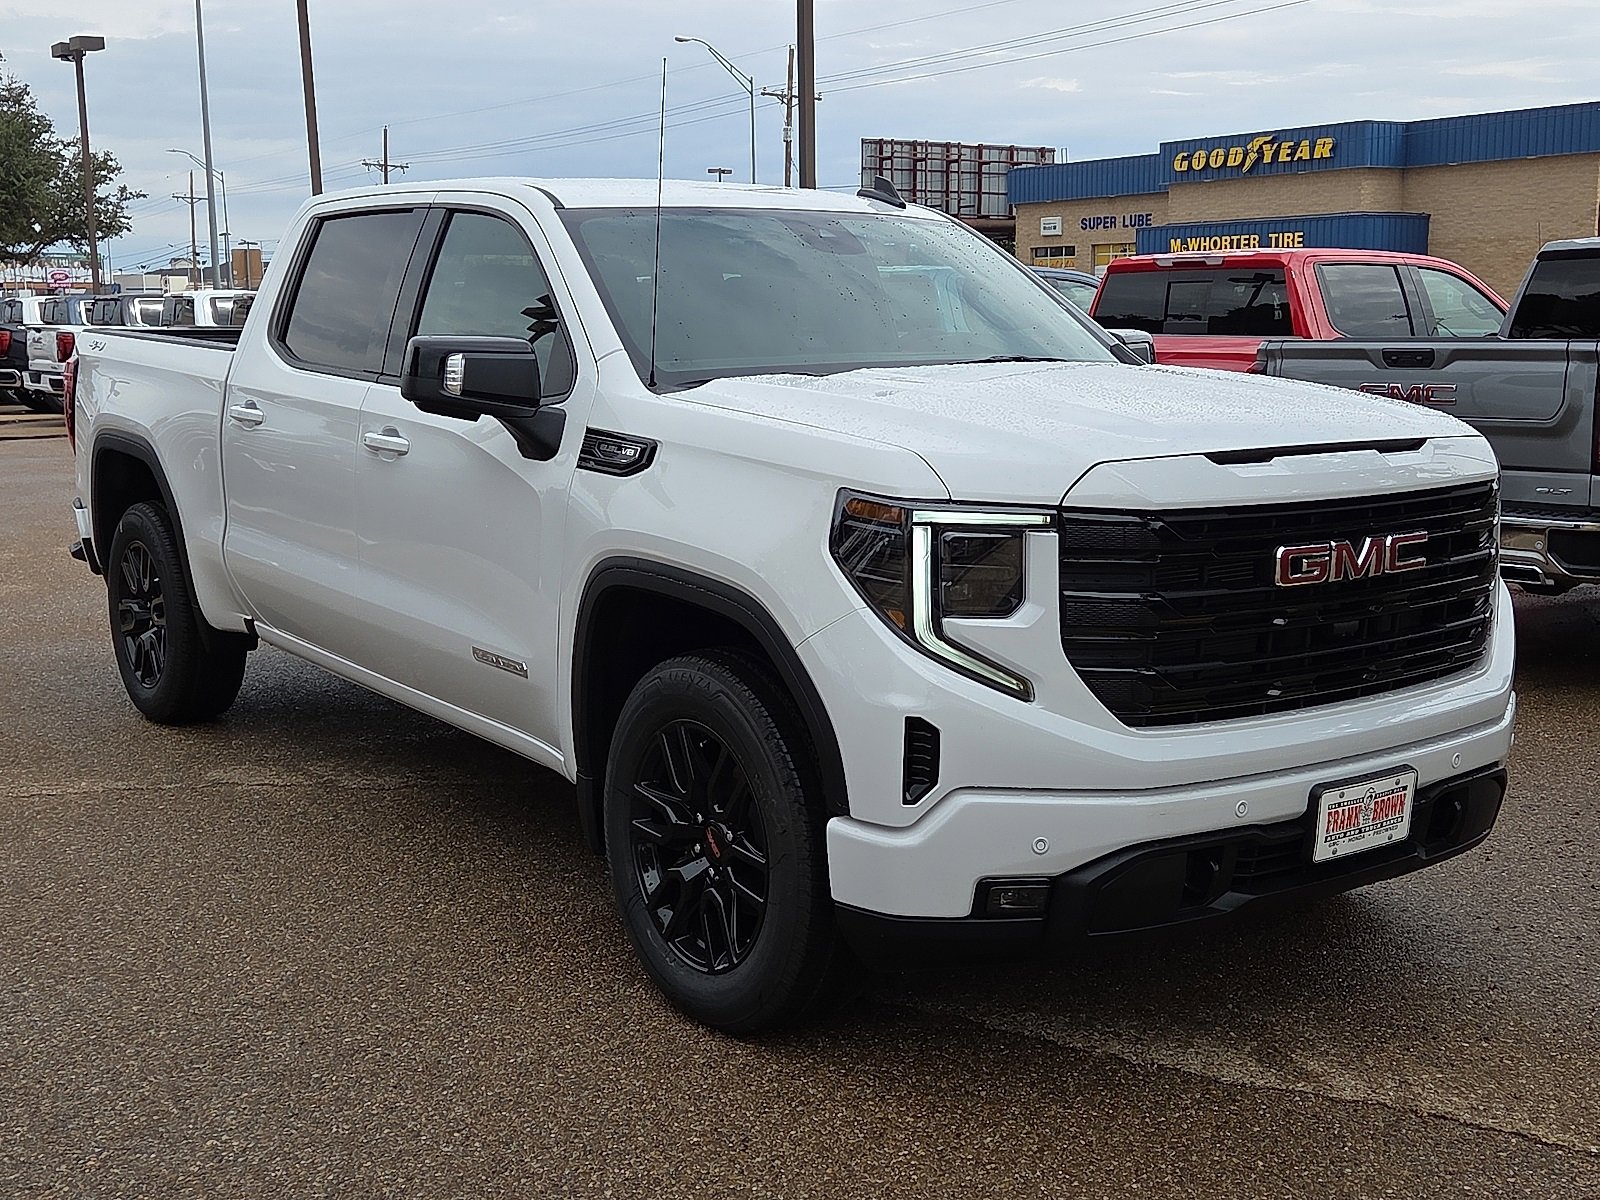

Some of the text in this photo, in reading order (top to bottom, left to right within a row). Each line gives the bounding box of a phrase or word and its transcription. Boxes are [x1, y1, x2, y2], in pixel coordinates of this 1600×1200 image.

[1173, 136, 1335, 173] GOODYEAR
[1080, 213, 1153, 230] SUPER LUBE
[1170, 231, 1304, 253] McWHORTER TIRE
[1359, 382, 1457, 406] GMC
[621, 447, 635, 456] V8
[1275, 531, 1428, 587] GMC
[1326, 793, 1407, 835] FRANK BROWN
[1326, 833, 1345, 841] AUTO
[1361, 824, 1382, 833] TRUCK
